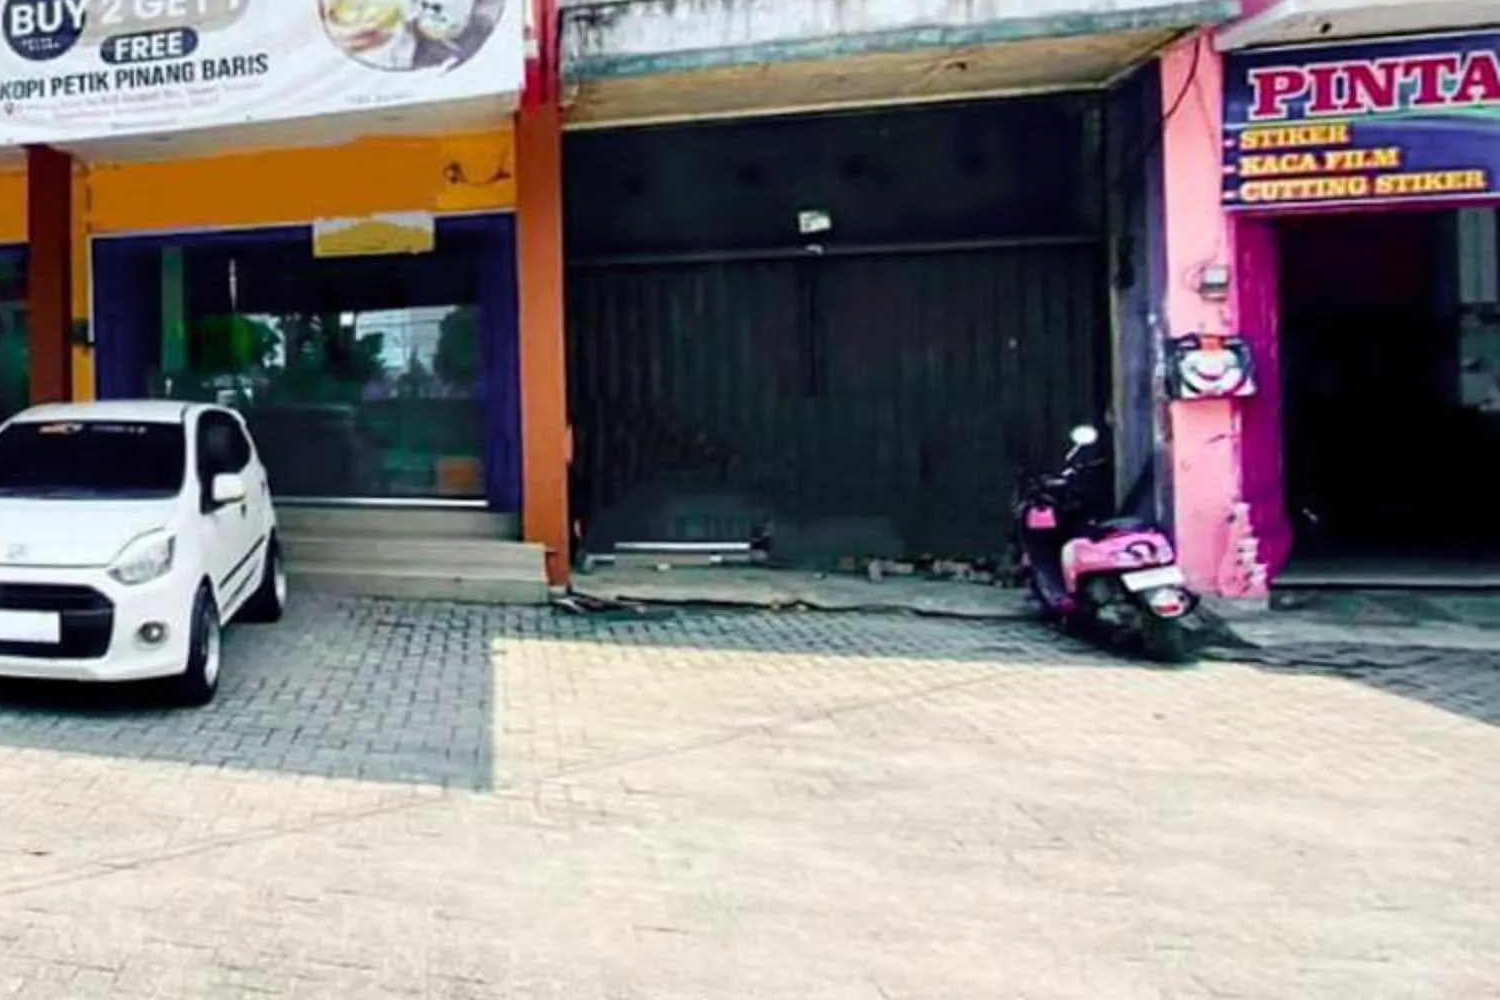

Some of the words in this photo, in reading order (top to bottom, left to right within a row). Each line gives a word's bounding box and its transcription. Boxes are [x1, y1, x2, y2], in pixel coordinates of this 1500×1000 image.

[114, 31, 184, 61] FREE
[0, 78, 46, 101] KOPI
[50, 71, 109, 97] PETIK
[115, 60, 196, 89] PINANG
[202, 52, 270, 81] BARIS
[1249, 49, 1500, 121] PINTA
[1239, 124, 1350, 150] STIKER
[1239, 152, 1319, 177] KACA
[1323, 147, 1400, 170] FILM
[1239, 176, 1368, 201] CUTTING
[1375, 169, 1488, 195] STIKER
